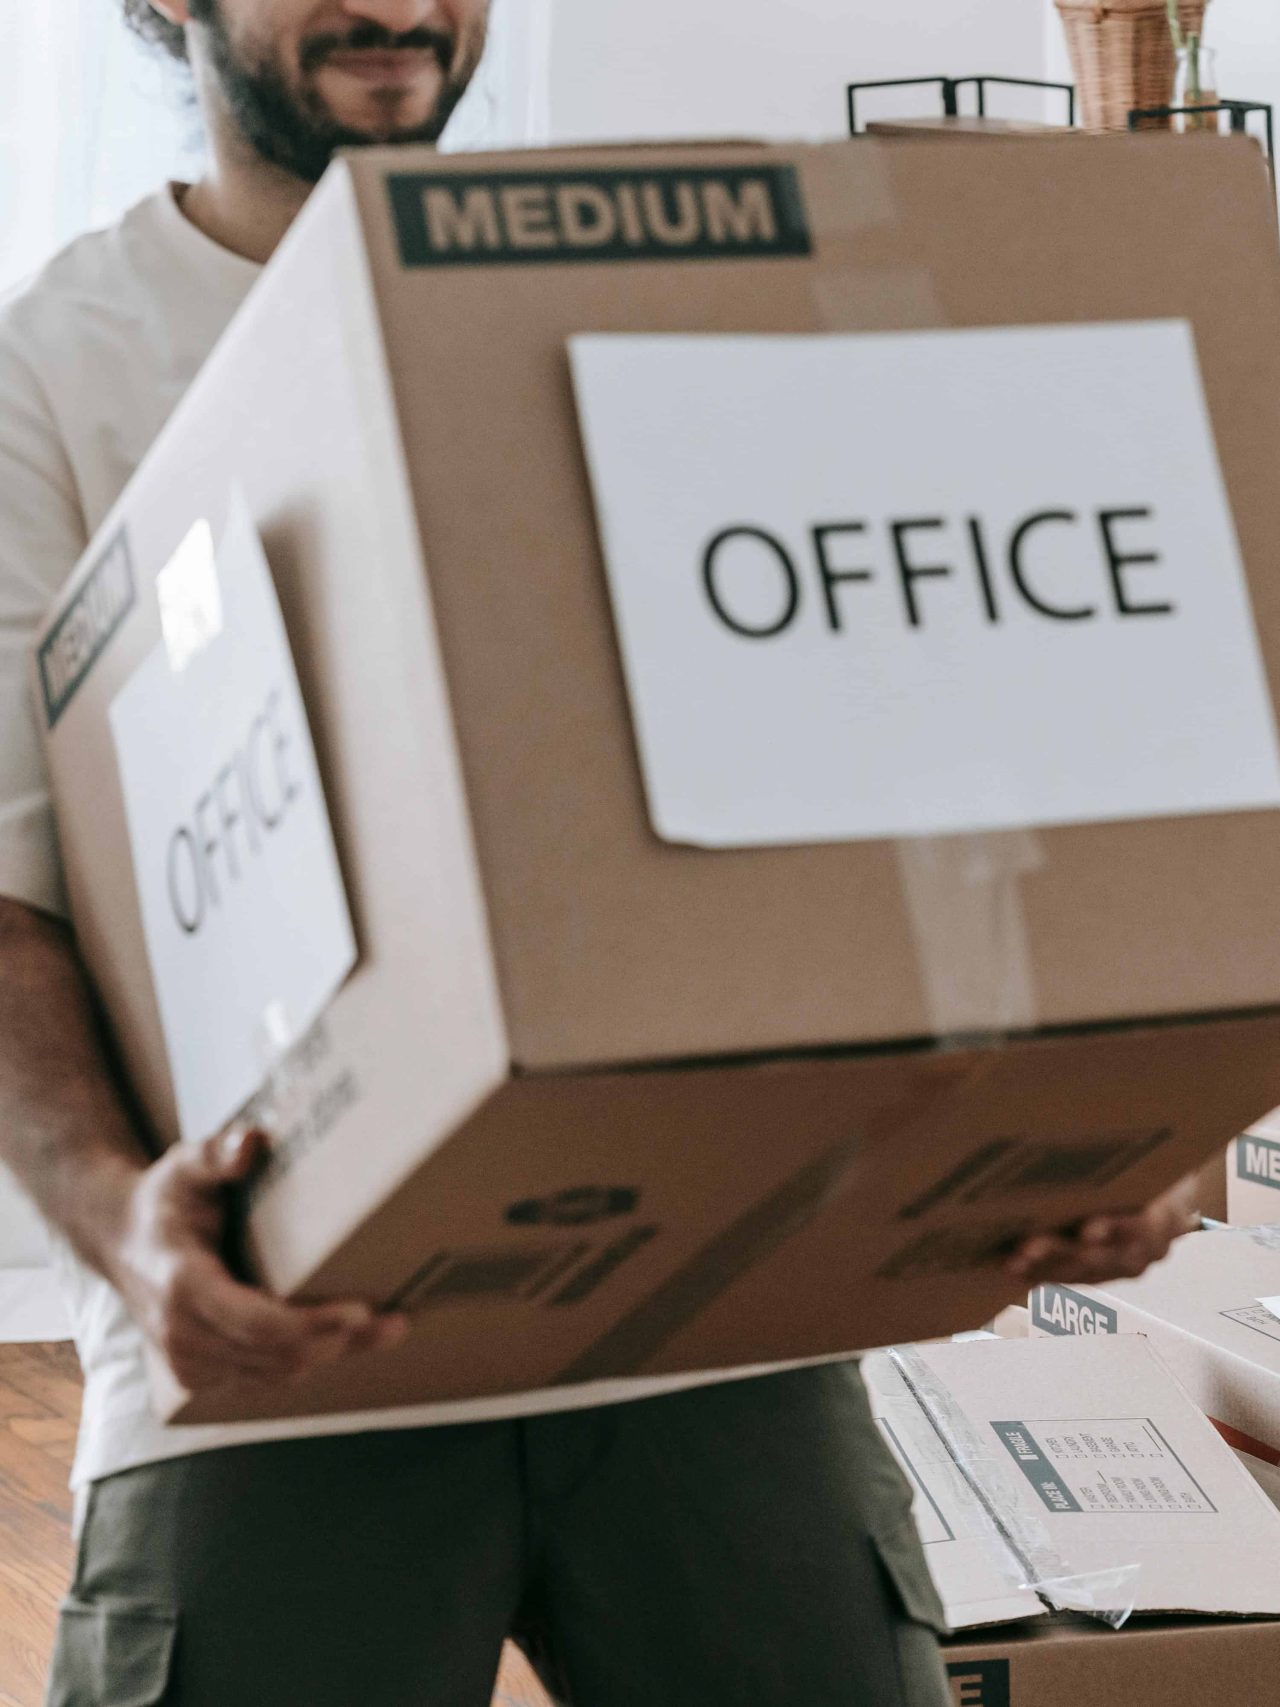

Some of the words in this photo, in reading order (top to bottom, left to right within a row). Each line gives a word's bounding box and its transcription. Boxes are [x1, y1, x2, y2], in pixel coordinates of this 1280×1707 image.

[422, 178, 778, 252] MEDIUM
[702, 505, 1175, 639] OFFICE
[165, 687, 301, 937] OFFICE
[1040, 1286, 1108, 1336] LARGE
[1006, 1432, 1032, 1453] FRAGILE
[1080, 1433, 1101, 1452] BASEMENT
[1046, 1490, 1070, 1508] PLACE
